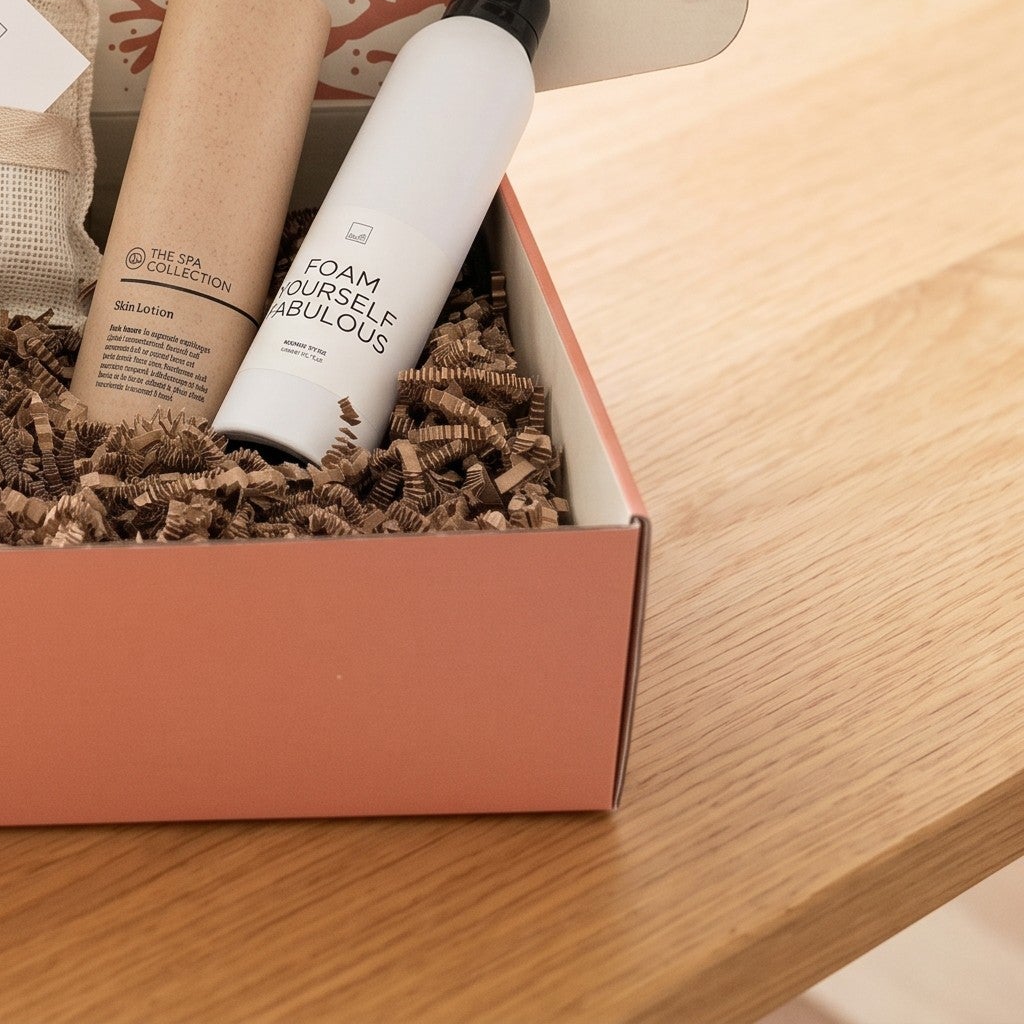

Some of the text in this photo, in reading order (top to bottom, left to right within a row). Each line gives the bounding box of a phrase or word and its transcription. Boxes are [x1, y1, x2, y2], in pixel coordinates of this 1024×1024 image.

[151, 248, 202, 270] THE SPA
[146, 260, 232, 294] COLLECTION
[303, 258, 381, 294] FOAM
[113, 300, 174, 320] Skin Lotion
